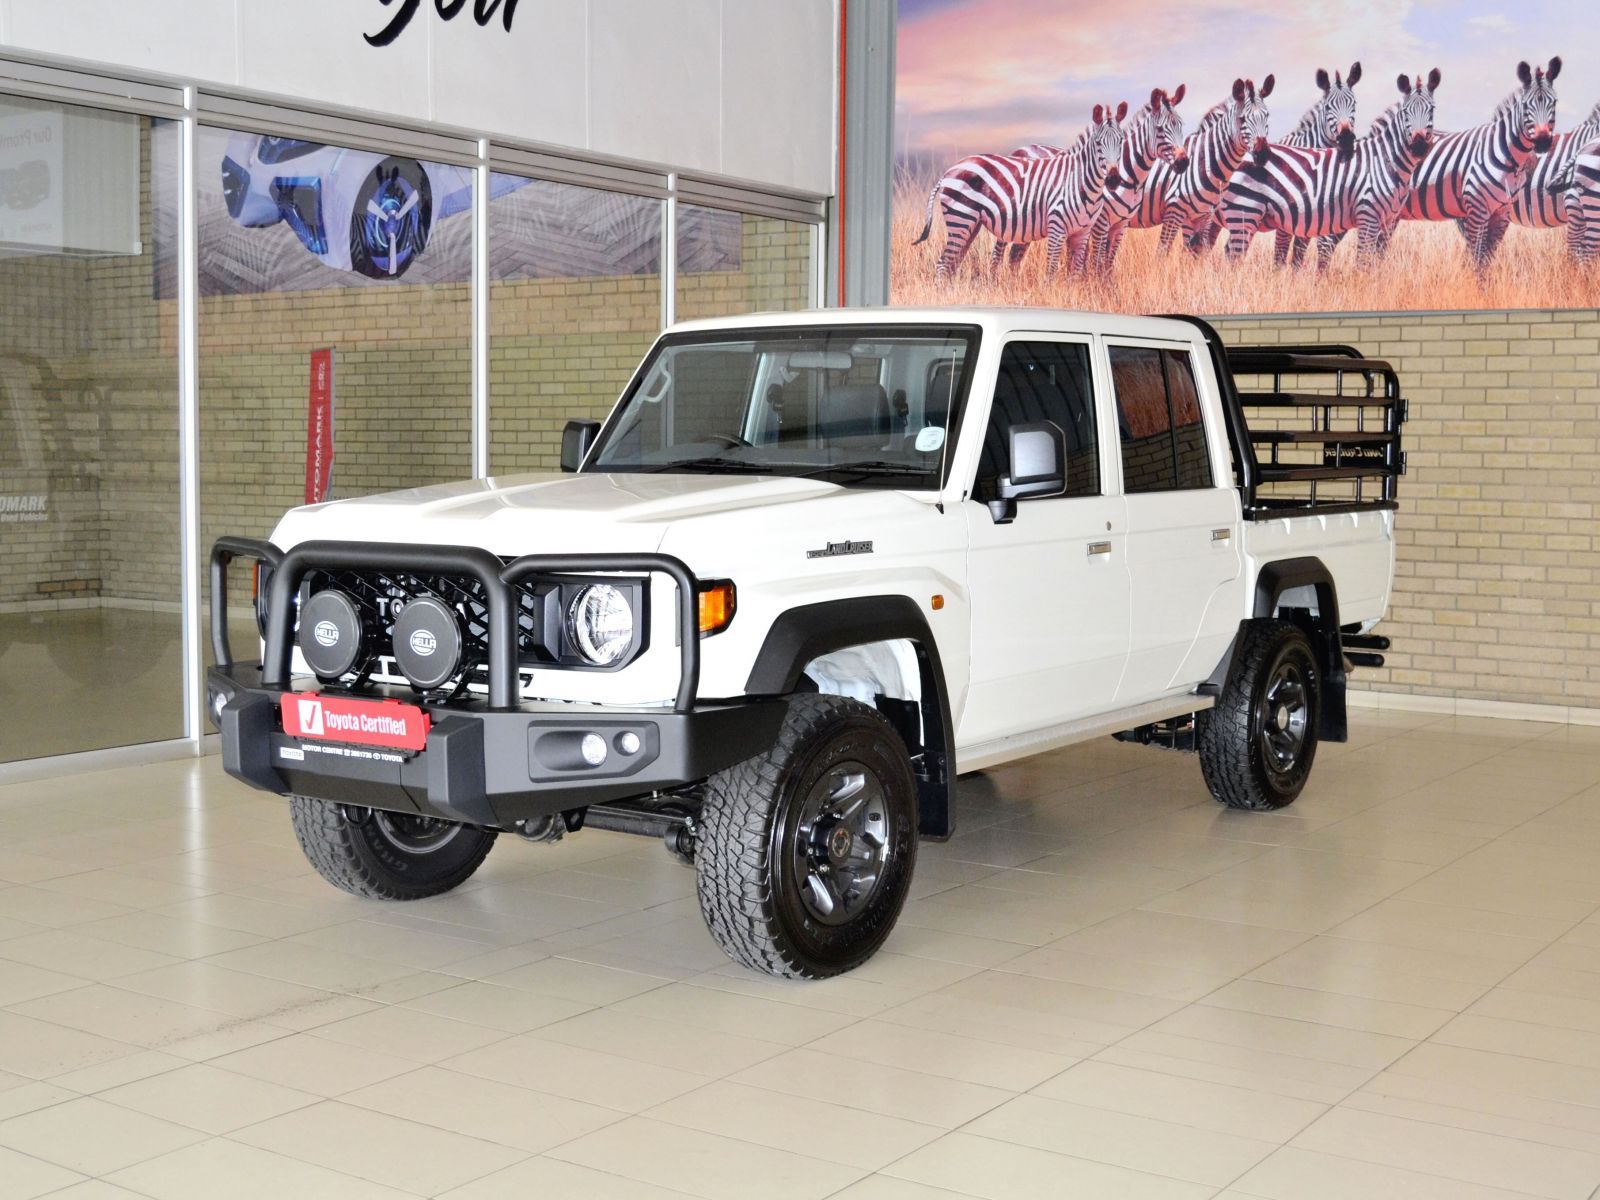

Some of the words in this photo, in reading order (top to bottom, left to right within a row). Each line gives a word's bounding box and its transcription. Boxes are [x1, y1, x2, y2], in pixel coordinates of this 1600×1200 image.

[315, 627, 339, 640] HELLA
[412, 637, 436, 649] HELLA
[324, 710, 360, 731] Toyota
[361, 714, 407, 736] Certified
[381, 753, 403, 763] TOYOTA
